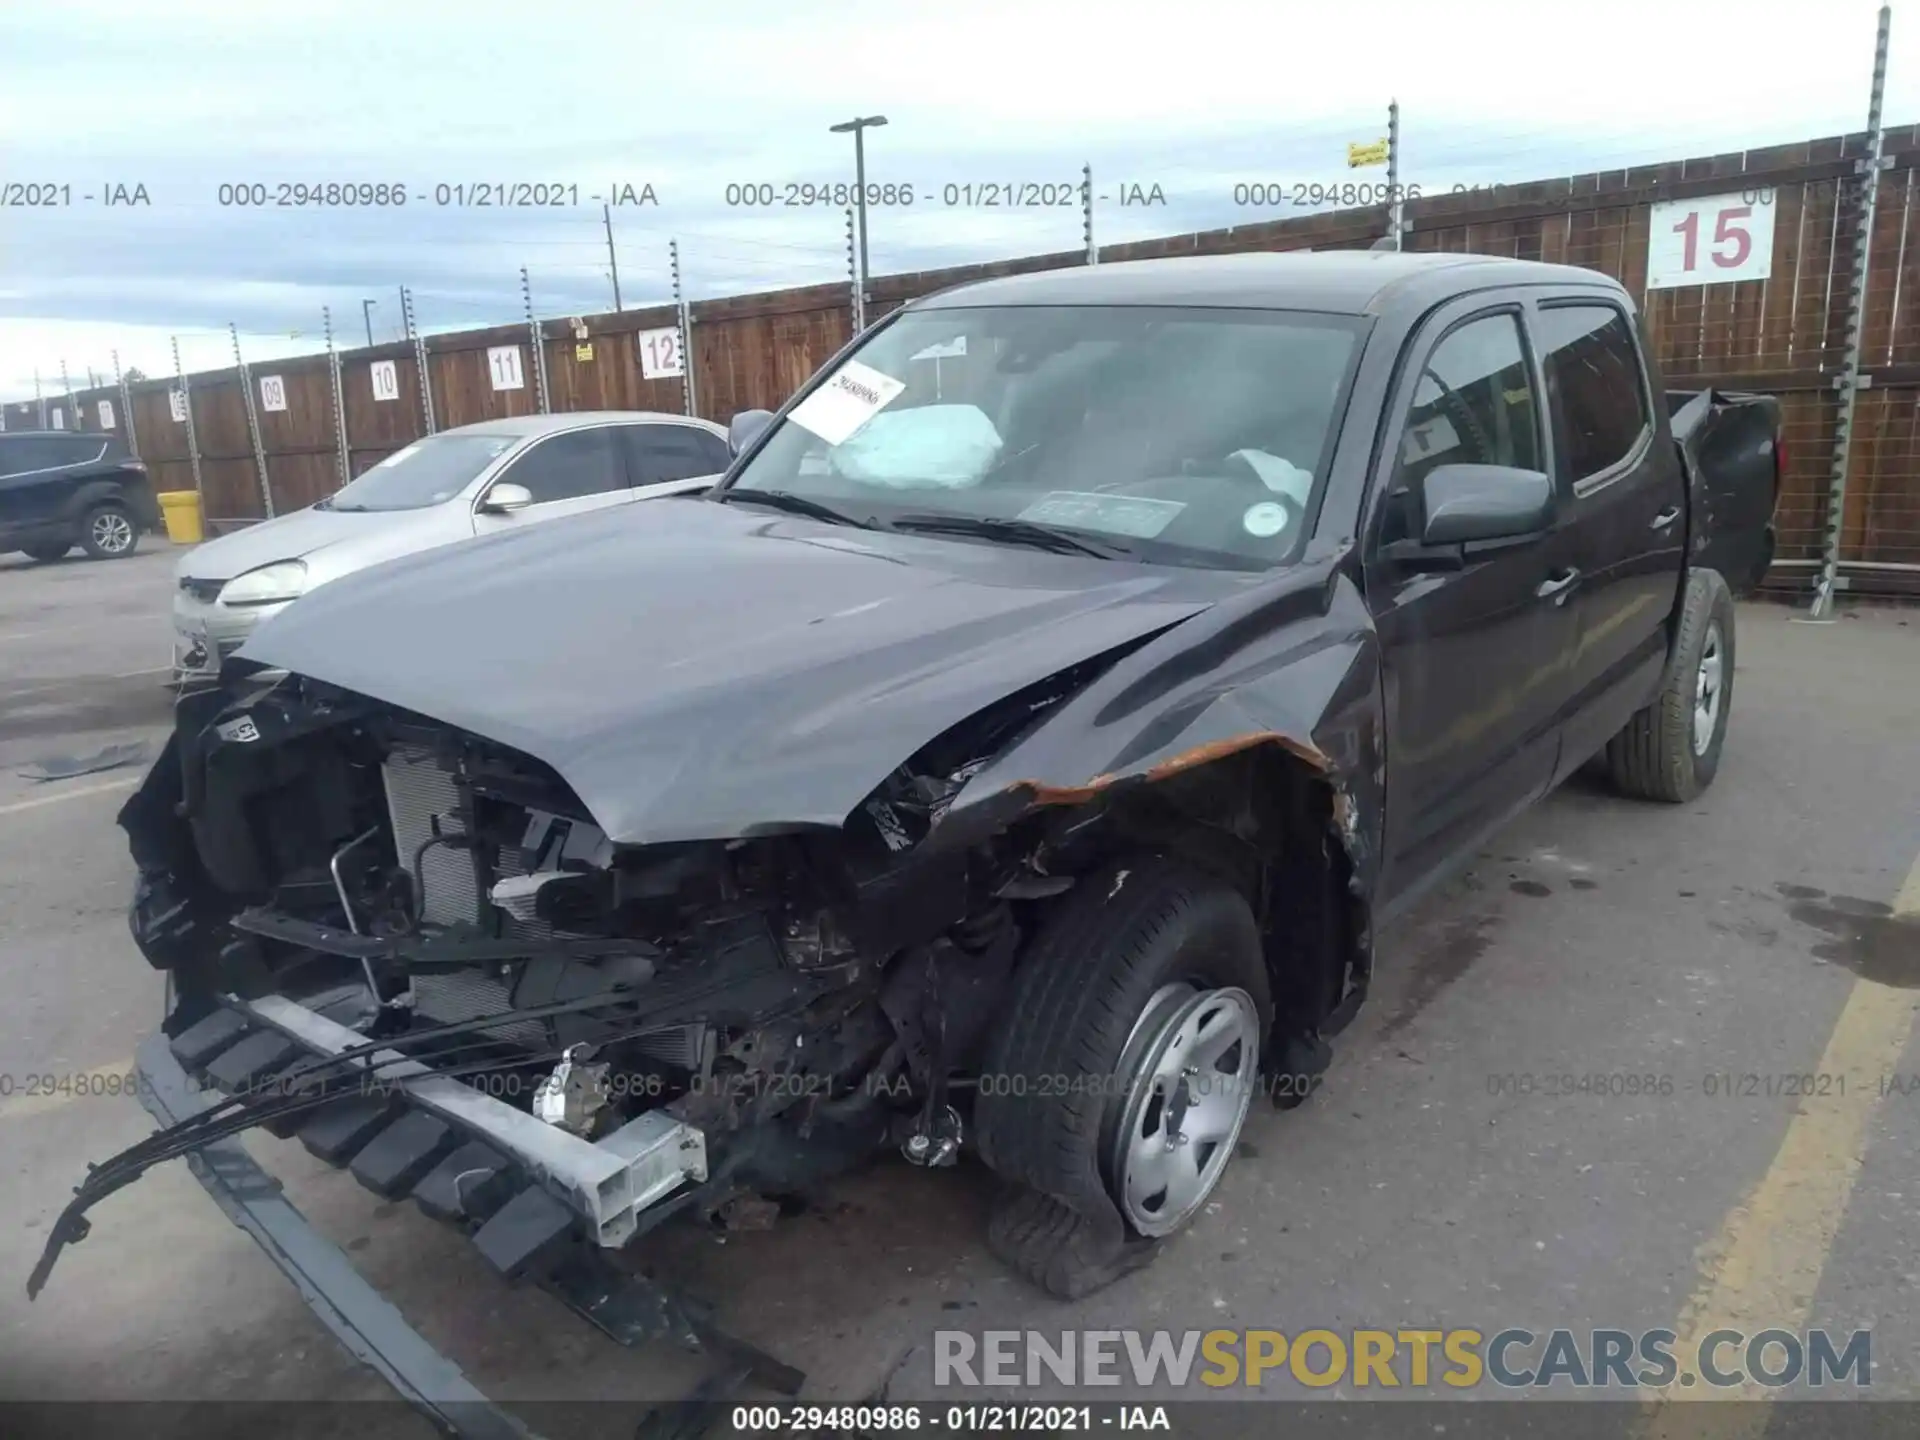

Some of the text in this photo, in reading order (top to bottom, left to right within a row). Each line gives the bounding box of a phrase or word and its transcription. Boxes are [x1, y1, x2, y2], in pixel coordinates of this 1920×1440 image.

[1672, 207, 1752, 272] 15
[494, 351, 516, 383] 11
[648, 335, 676, 370] 12
[264, 381, 281, 405] 09
[375, 364, 394, 395] 10
